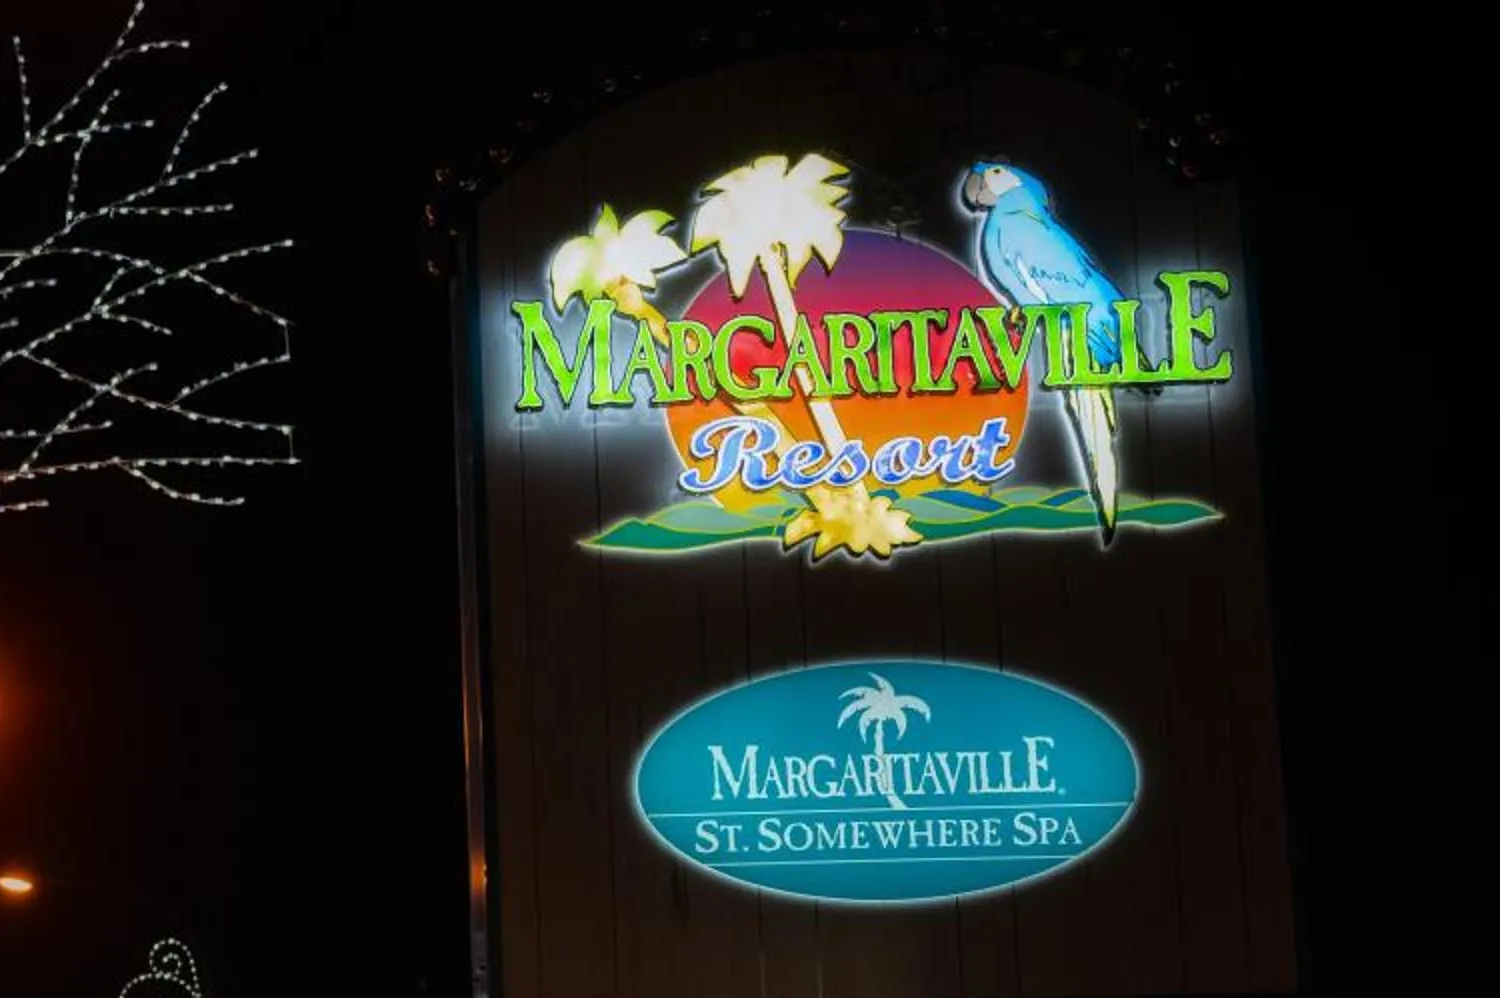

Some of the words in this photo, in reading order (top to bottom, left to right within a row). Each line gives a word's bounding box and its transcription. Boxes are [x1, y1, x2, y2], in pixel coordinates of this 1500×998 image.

[512, 270, 1233, 409] MARGARITAVILLE
[680, 415, 1016, 494] Resort
[708, 736, 1057, 801] MARGARITAVILLE
[695, 819, 749, 854] ST.
[758, 818, 1001, 852] SOMEWHERE
[1012, 811, 1083, 847] SPA
